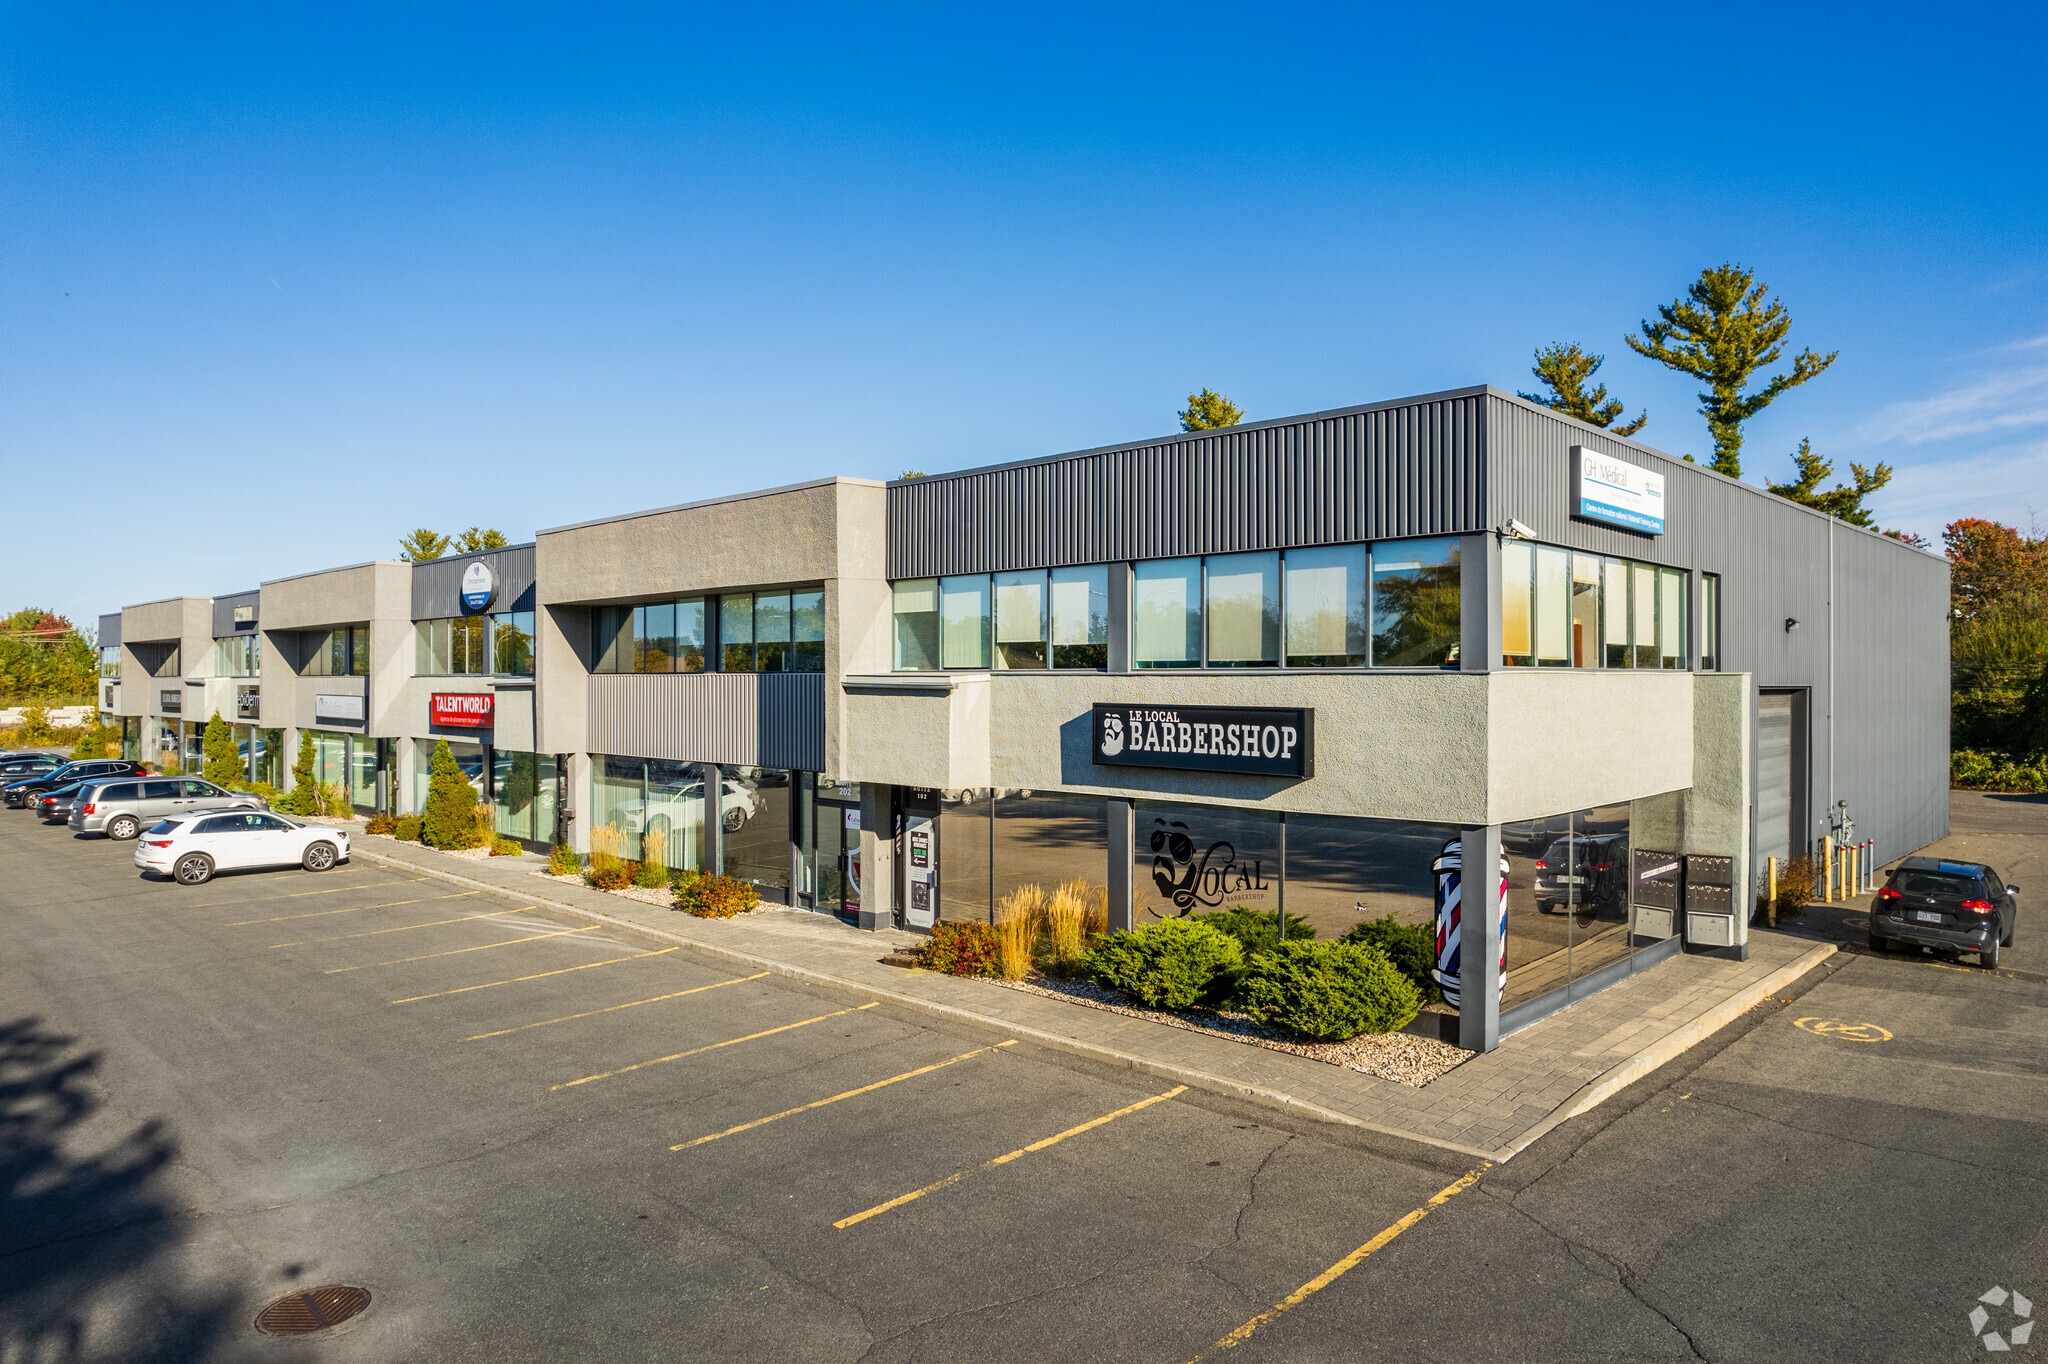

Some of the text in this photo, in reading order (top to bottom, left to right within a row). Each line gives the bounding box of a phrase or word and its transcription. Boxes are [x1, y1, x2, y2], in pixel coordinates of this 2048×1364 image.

[435, 696, 490, 713] TALENTWORLD
[1129, 710, 1180, 723] LE LOCAL
[1129, 721, 1297, 759] BARBERSHOP
[839, 787, 852, 796] 202
[1226, 893, 1265, 903] BARBERSHOP
